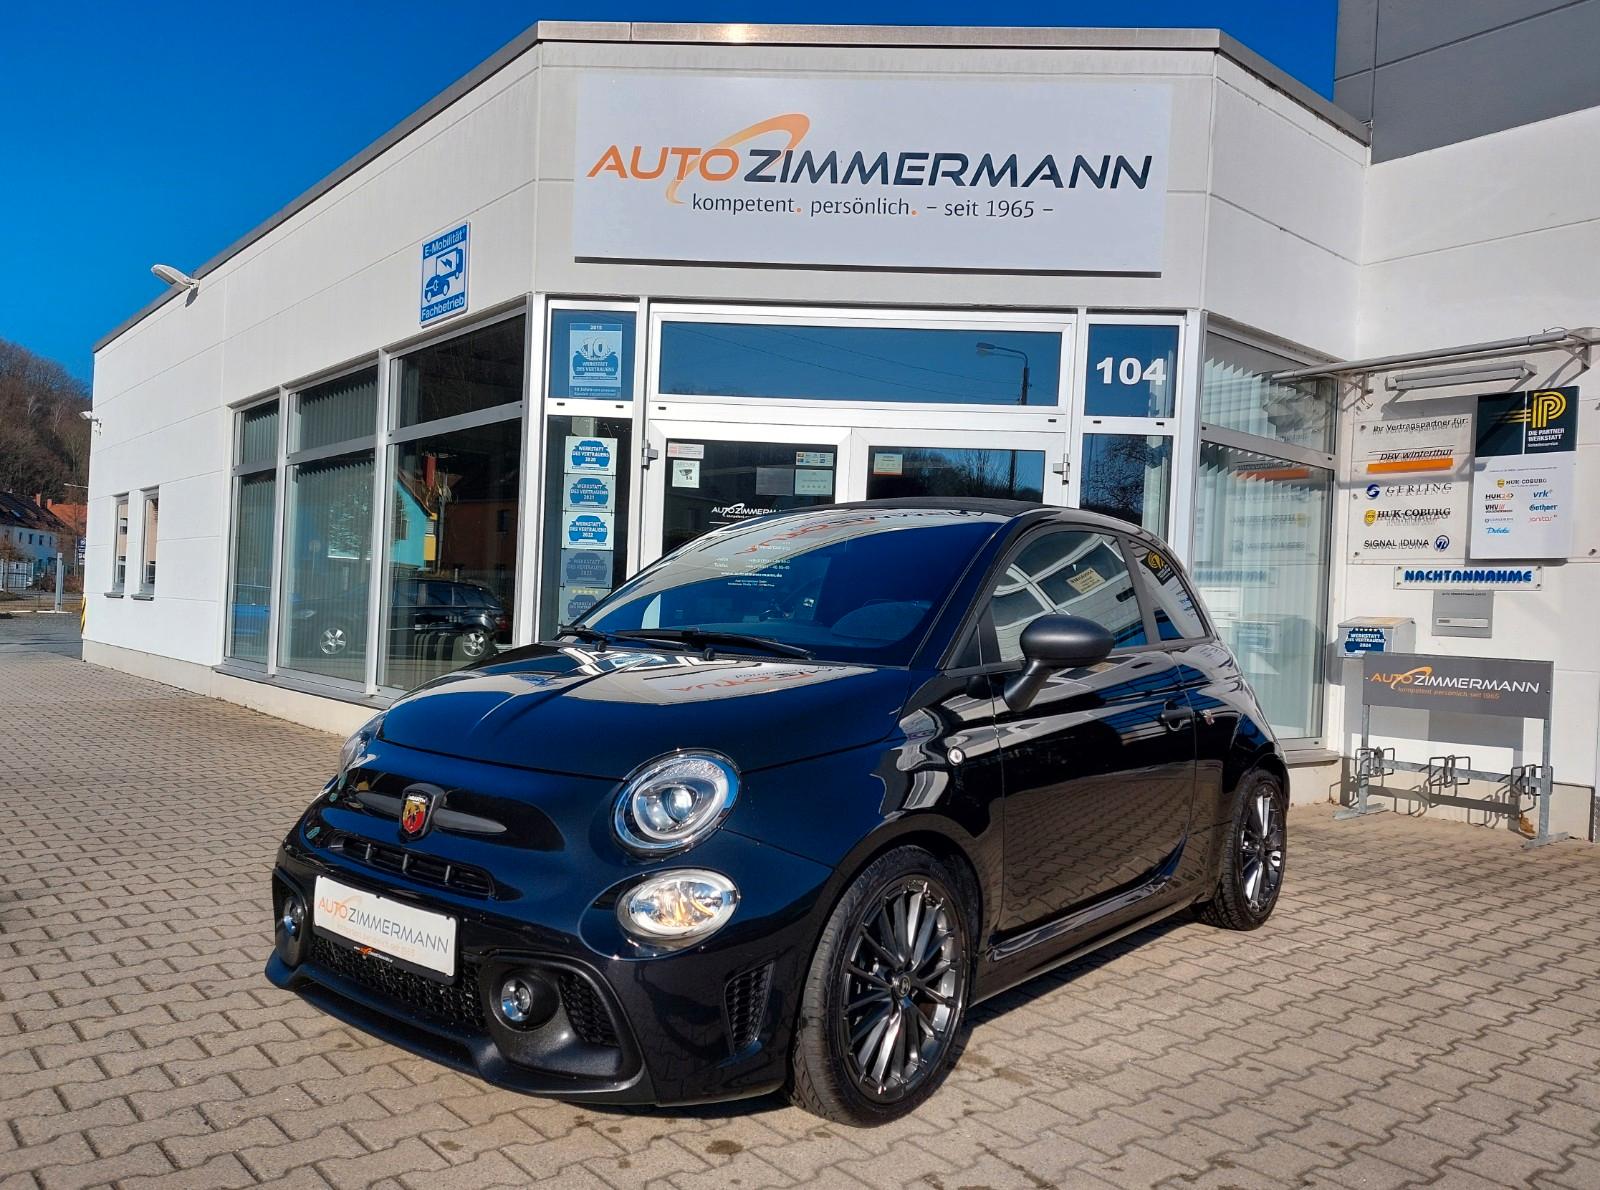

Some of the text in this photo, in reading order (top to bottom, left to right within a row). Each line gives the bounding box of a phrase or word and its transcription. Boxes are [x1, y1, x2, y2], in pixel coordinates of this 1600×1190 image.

[692, 192, 802, 216] kompetent.
[810, 196, 918, 218] persönlich.
[944, 200, 979, 218] seit
[985, 200, 1035, 219] 1965
[421, 295, 464, 320] Fachbetrieb
[1096, 356, 1167, 386] 104
[1387, 419, 1451, 431] Vertragspartner
[1538, 427, 1565, 436] PARTNER
[1528, 434, 1562, 442] WERKSTATT
[1379, 452, 1400, 461] DBV
[1386, 482, 1452, 494] GERLING
[1377, 507, 1451, 518] HUK-COBURG
[1363, 538, 1430, 548] SIGNAL IDUNA
[1405, 570, 1533, 583] NACHTANNAHME
